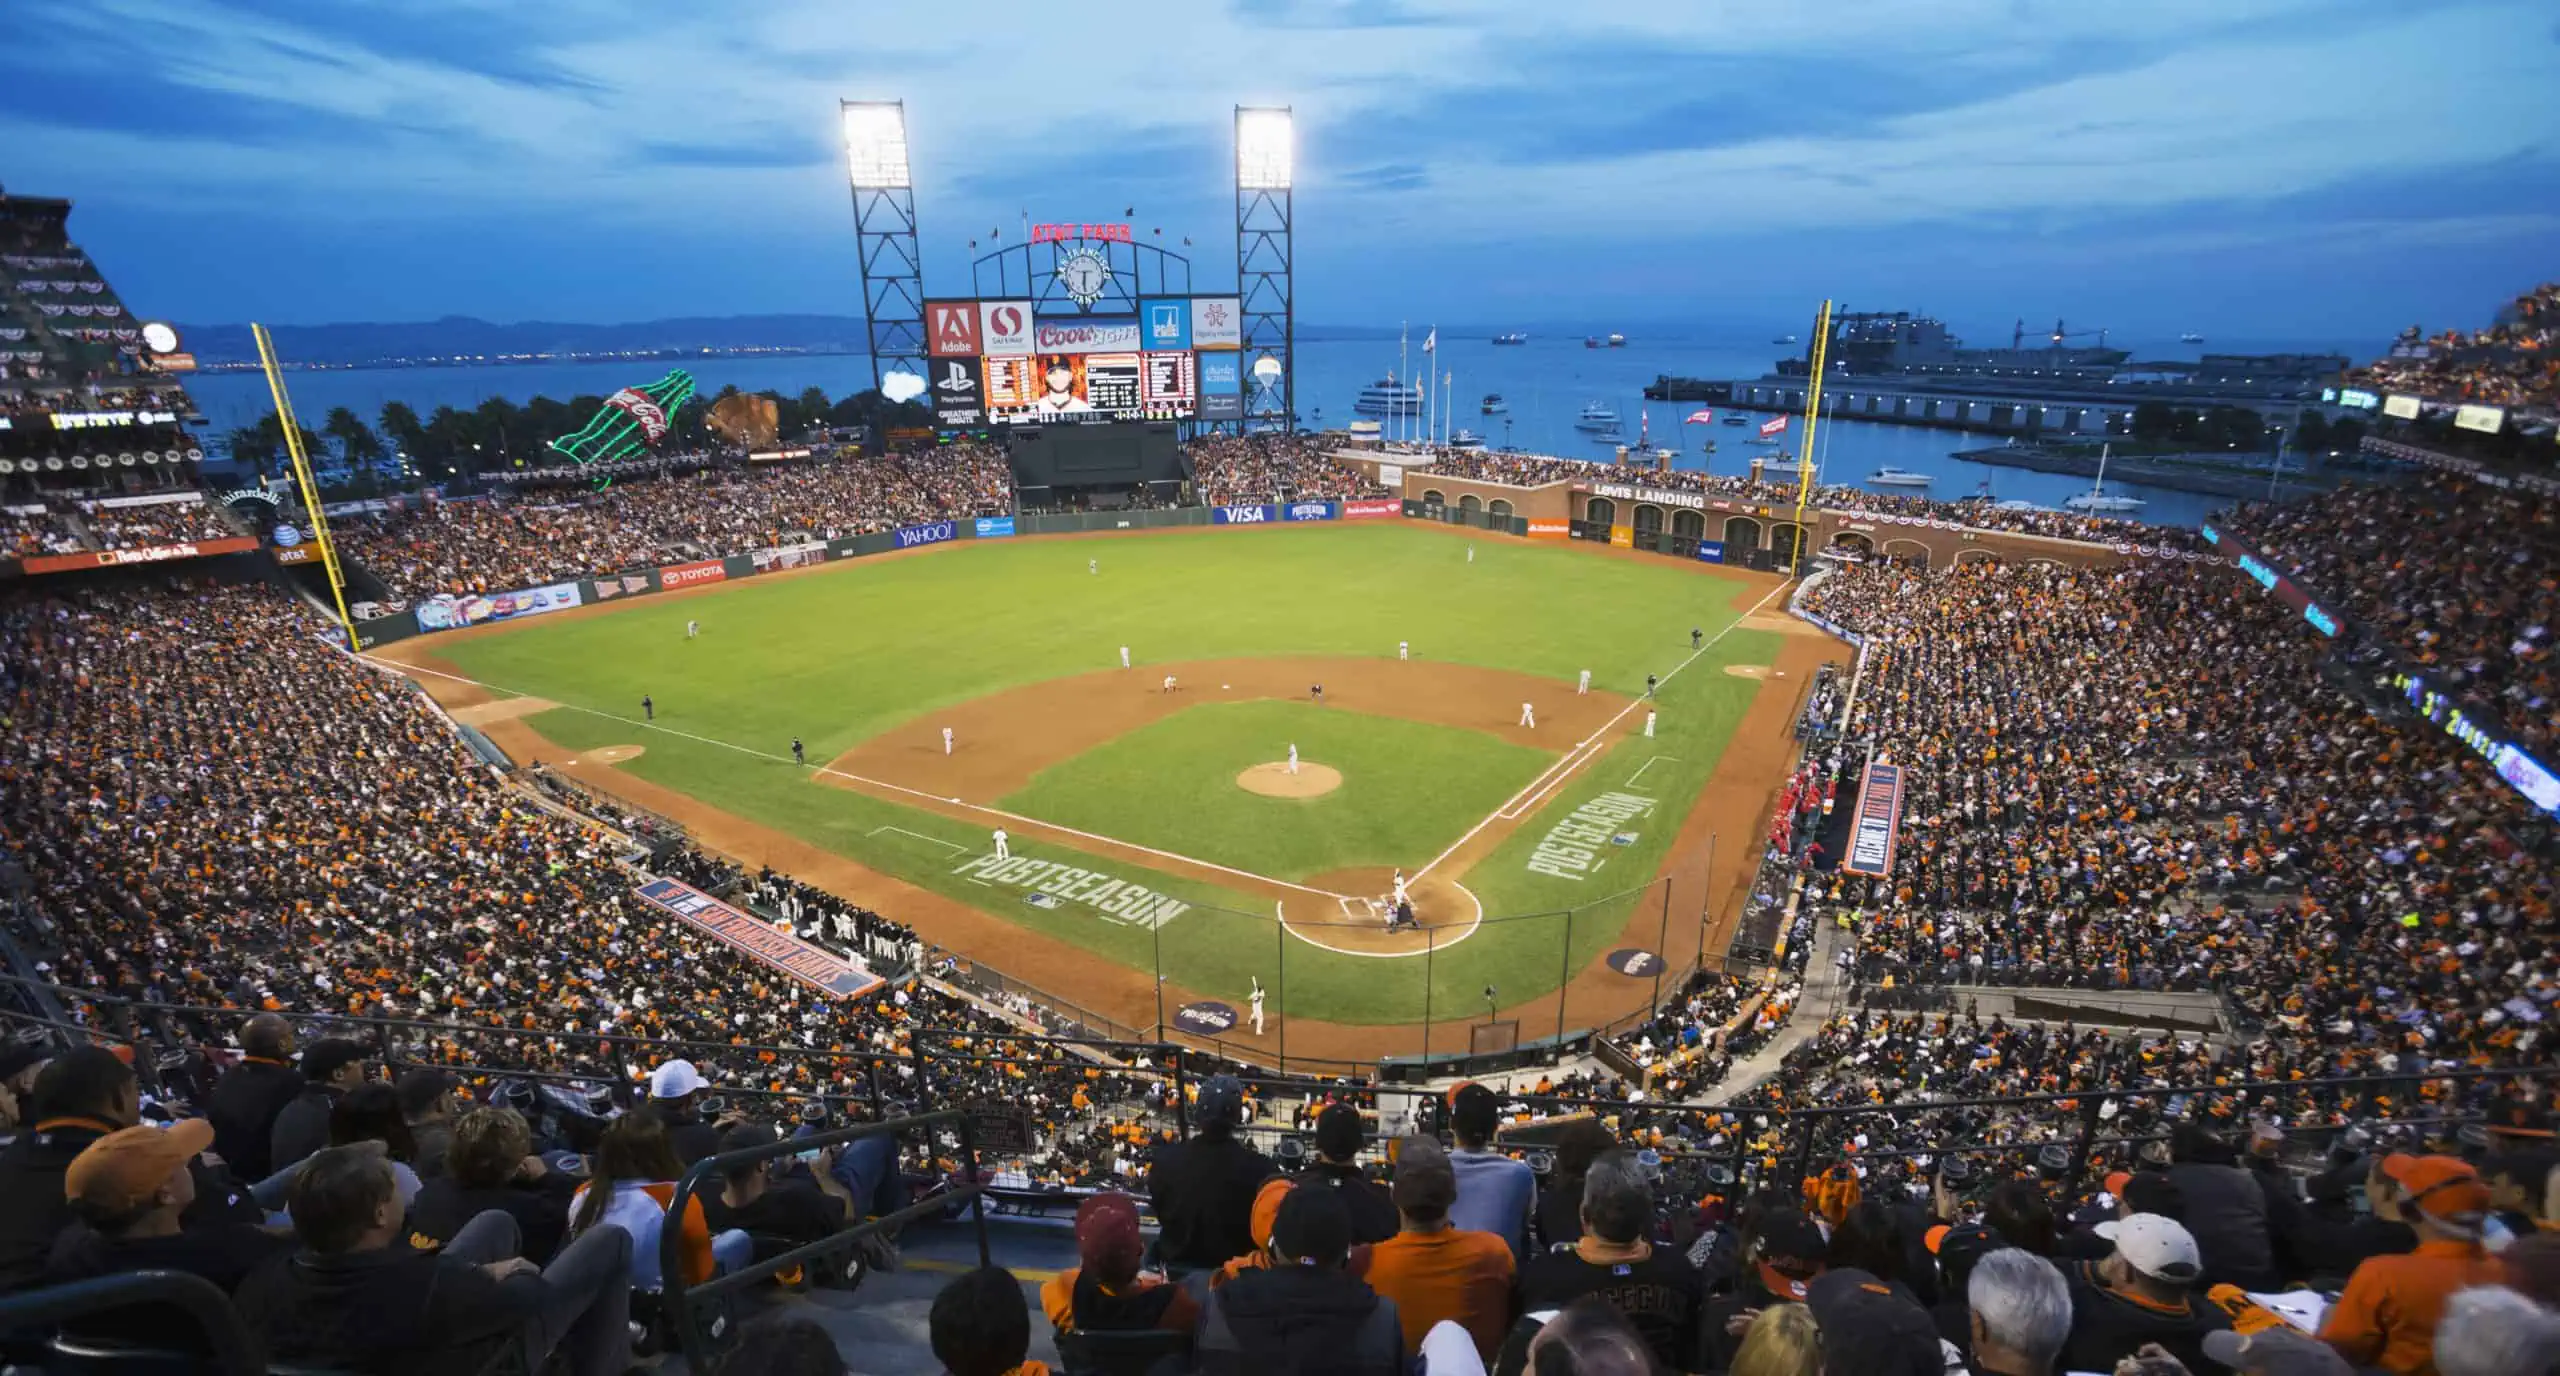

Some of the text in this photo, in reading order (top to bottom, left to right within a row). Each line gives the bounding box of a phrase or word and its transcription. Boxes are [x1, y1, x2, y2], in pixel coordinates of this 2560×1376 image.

[941, 340, 972, 353] Adobe
[1636, 489, 1704, 508] LANDING
[1224, 507, 1264, 523] VISA
[900, 523, 952, 547] YAHOO!
[680, 565, 725, 580] TOYOTA
[1527, 791, 1659, 881] POSTSEASON
[951, 853, 1192, 931] POSTSEASON
